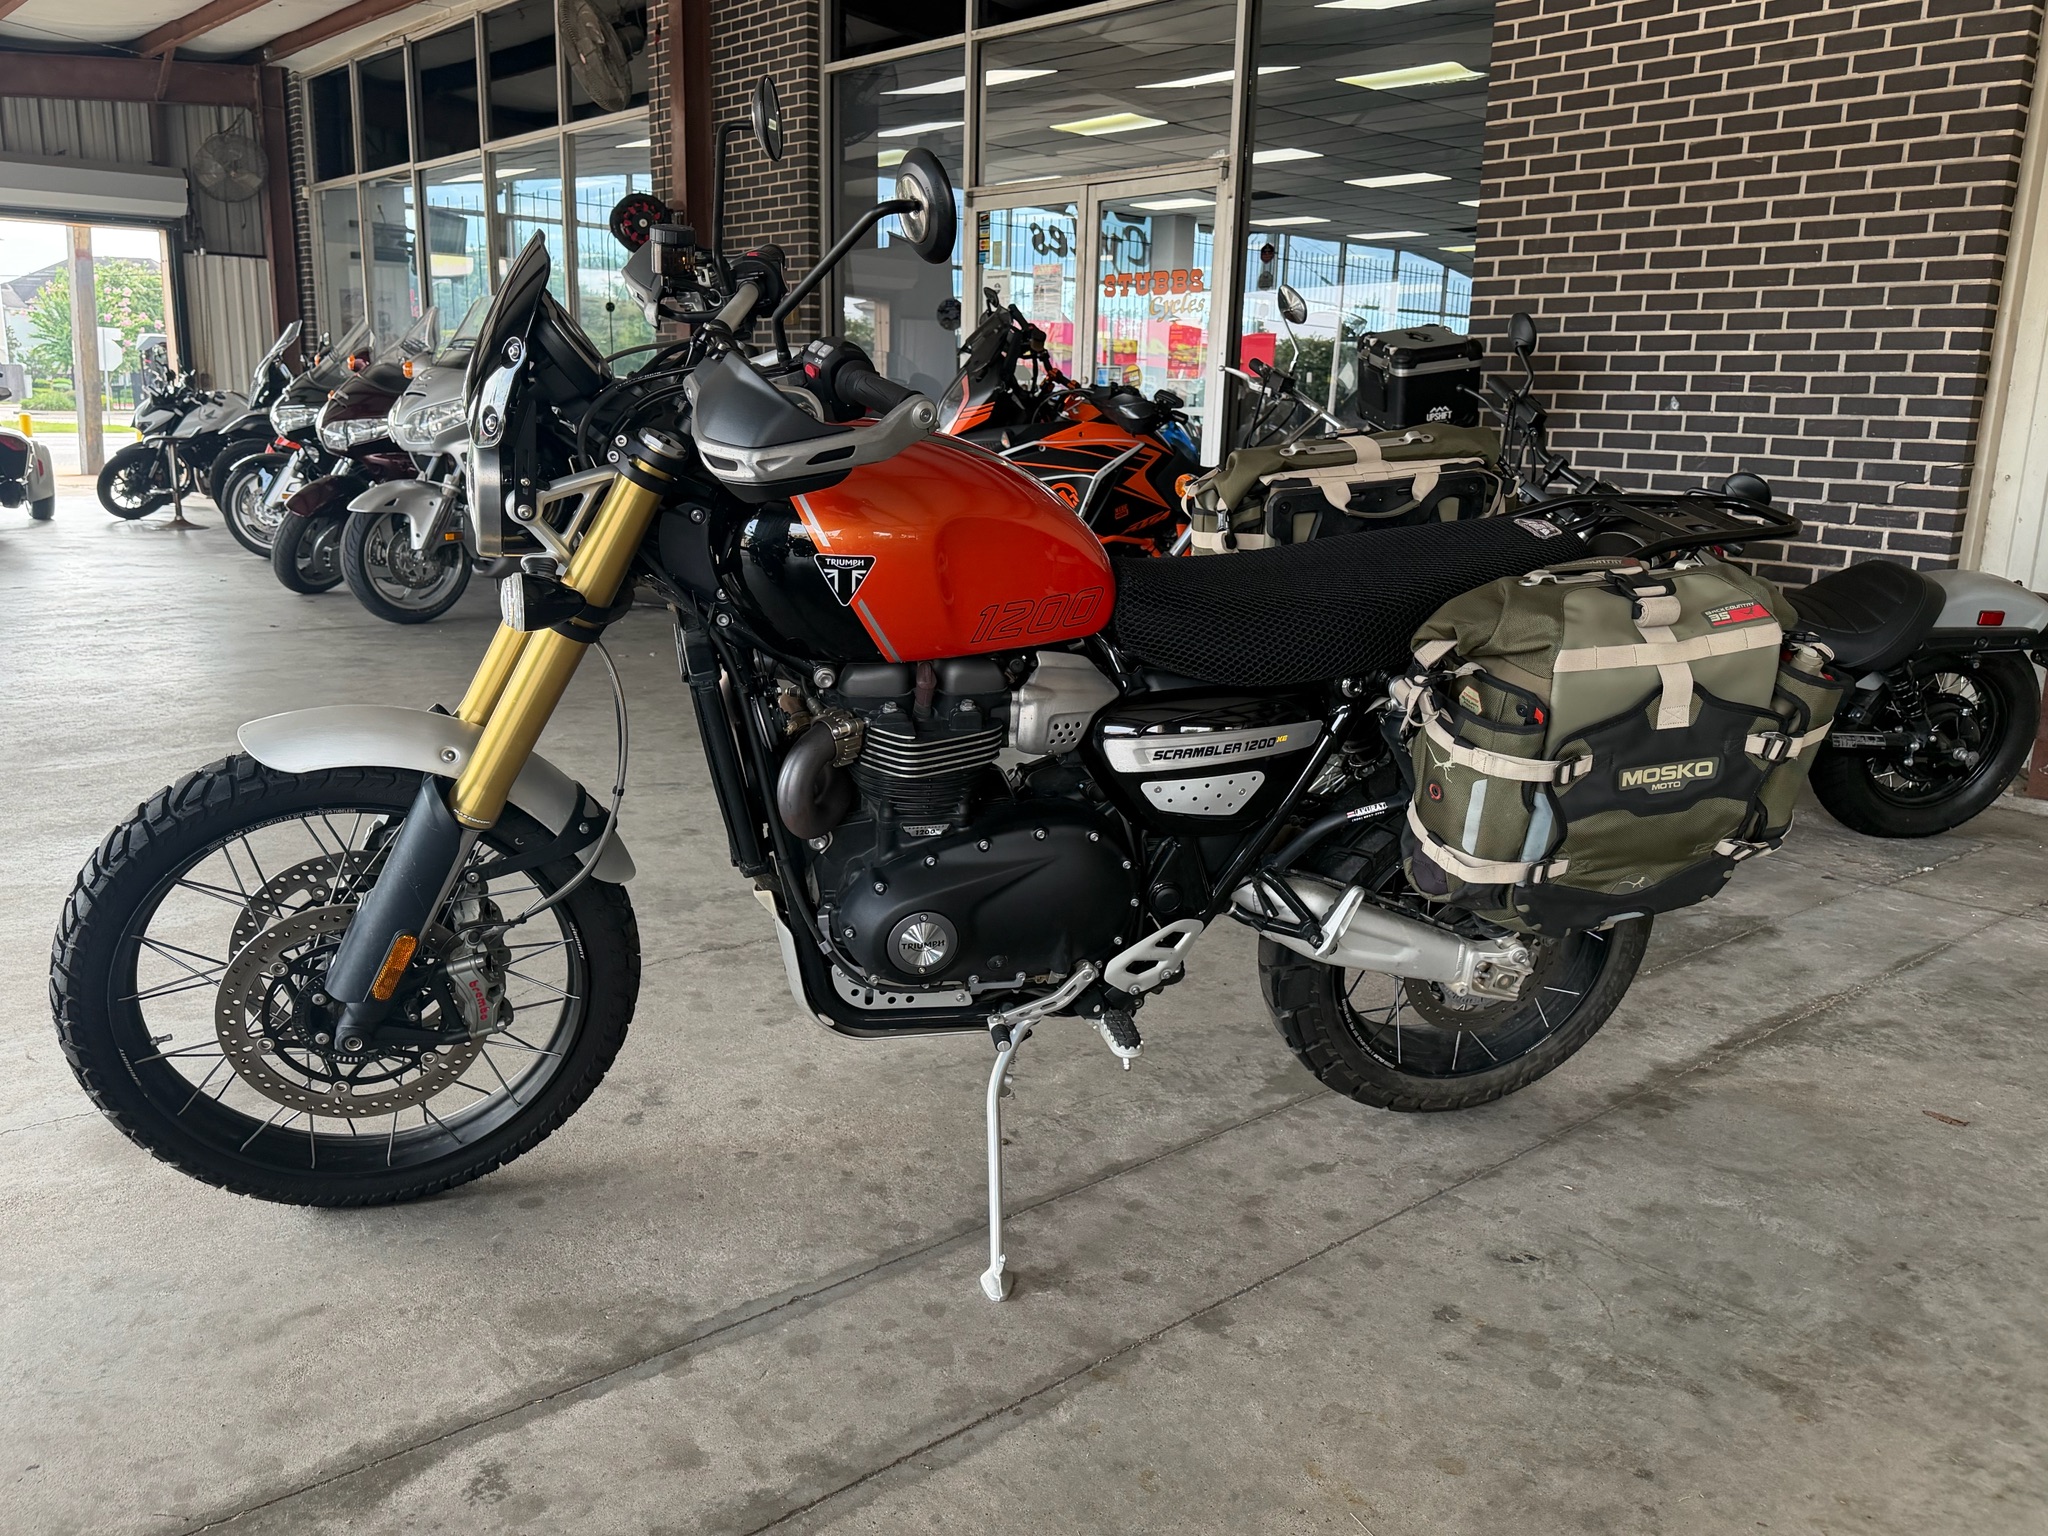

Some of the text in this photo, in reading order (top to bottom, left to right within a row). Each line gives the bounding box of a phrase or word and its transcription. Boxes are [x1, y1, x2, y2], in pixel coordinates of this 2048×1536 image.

[1104, 268, 1204, 297] STUBBS
[1149, 292, 1206, 322] Cycles
[1426, 410, 1453, 422] UPSHIFT
[825, 557, 865, 568] TRIUMPH
[971, 586, 1104, 643] 1200
[1709, 611, 1730, 622] 35
[1153, 743, 1242, 761] SCRAMBLER
[1244, 737, 1277, 752] 1200
[1621, 761, 1713, 787] MOSKO
[1651, 781, 1681, 791] MOTO
[901, 940, 945, 952] TRIUMPH
[469, 980, 490, 1021] brembo
